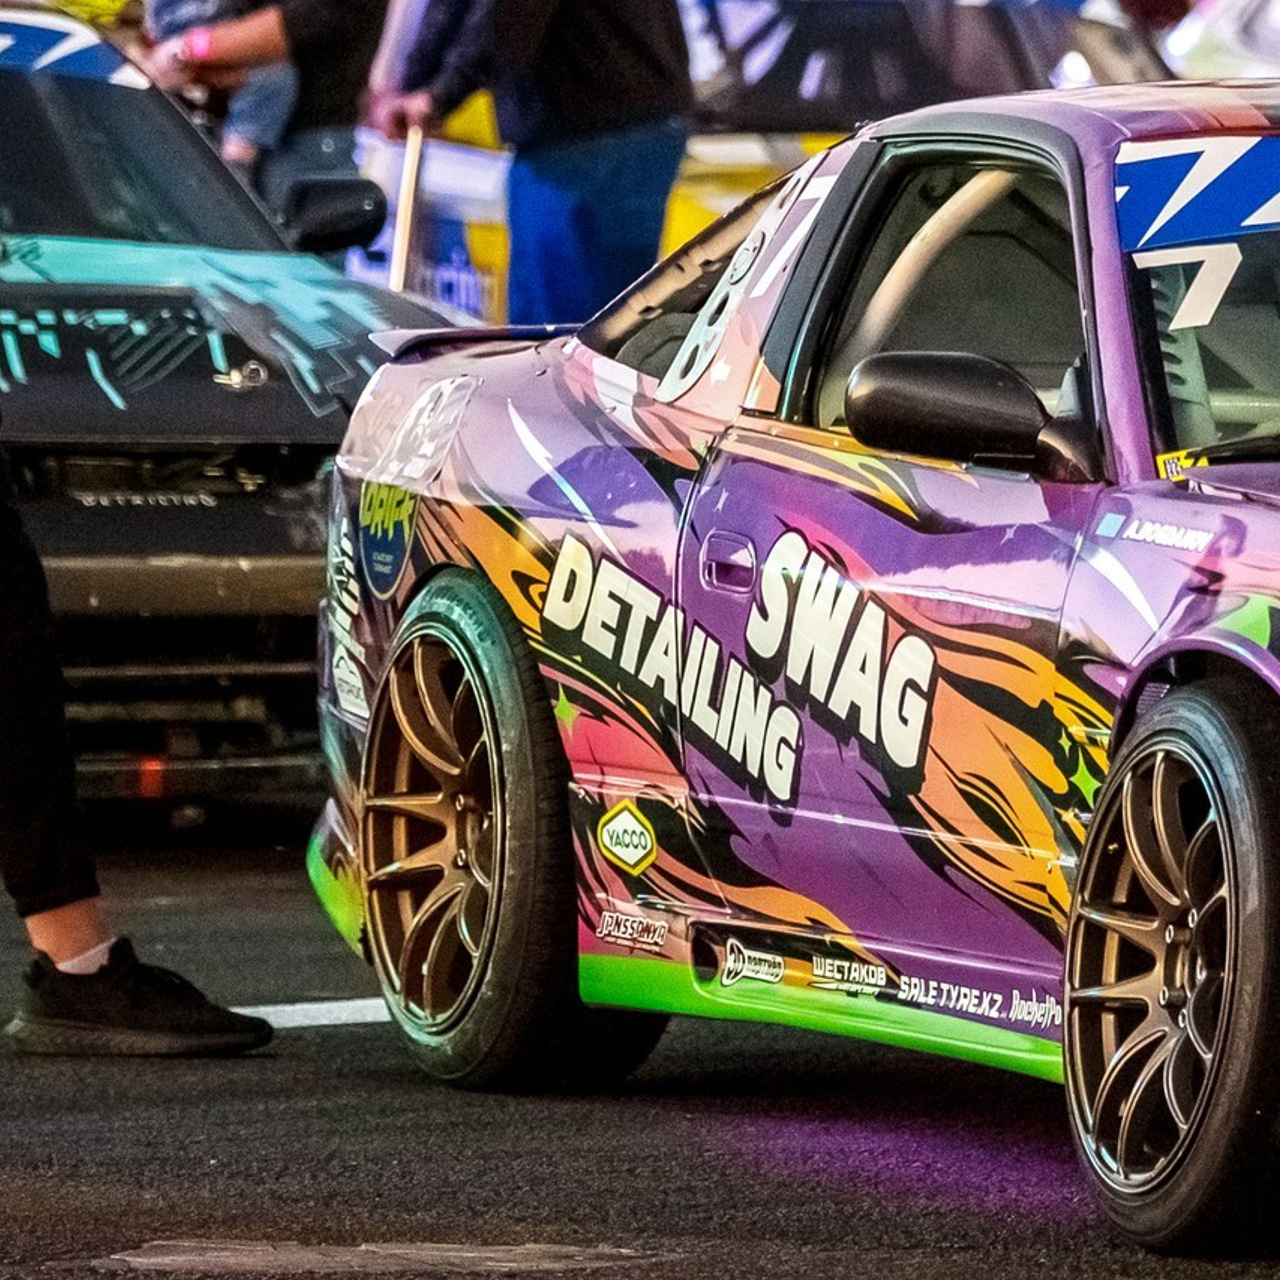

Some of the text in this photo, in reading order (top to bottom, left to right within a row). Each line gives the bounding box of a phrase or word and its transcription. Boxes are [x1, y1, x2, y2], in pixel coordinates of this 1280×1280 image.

[1132, 242, 1243, 331] 7
[541, 532, 800, 803] DETAILING
[745, 530, 935, 769] SWAG
[605, 828, 648, 850] YACCO
[812, 956, 887, 986] ШЕСТАКОВ
